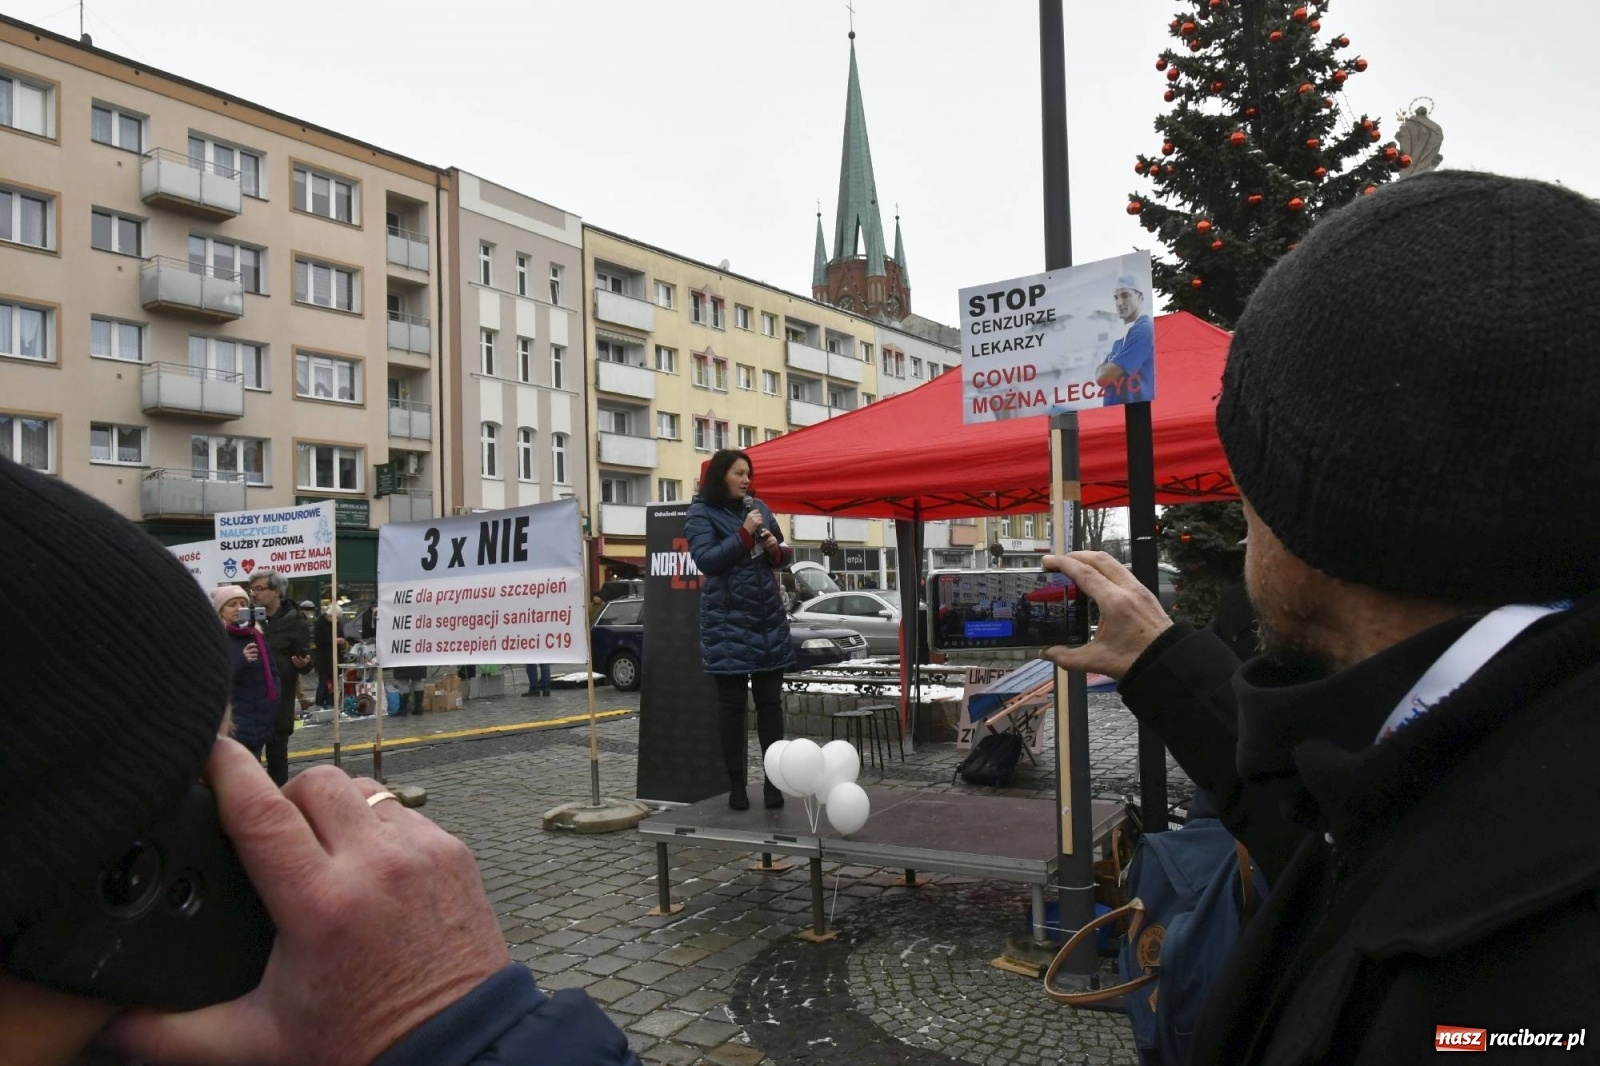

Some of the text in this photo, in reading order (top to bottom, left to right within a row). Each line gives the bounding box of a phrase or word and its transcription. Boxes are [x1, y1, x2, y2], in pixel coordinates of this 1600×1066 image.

[969, 284, 1046, 317] STOP
[970, 308, 1057, 335] CENZURZE
[971, 333, 1045, 358] LEKARZY
[972, 364, 1037, 389] COVID
[972, 370, 1142, 414] MOŻNA LECZYĆ
[219, 514, 261, 527] SŁUŻBY
[262, 507, 321, 523] MUNDUROWE
[219, 524, 289, 538] NAUCZYCIELE
[220, 535, 304, 551] SŁUŻBY ZDROWIA
[270, 547, 332, 562] ONI TEŻ MAJĄ
[421, 516, 530, 571] 3 x NIE
[179, 551, 201, 562] NOŚĆ
[293, 560, 332, 573] WYBORU
[651, 552, 703, 576] NORYM
[393, 577, 567, 605] NIE dla przymusu szczepień
[392, 606, 572, 631] NIE dla segregacji sanitarnej
[391, 632, 572, 655] NIE dla szczepień dzieci C19
